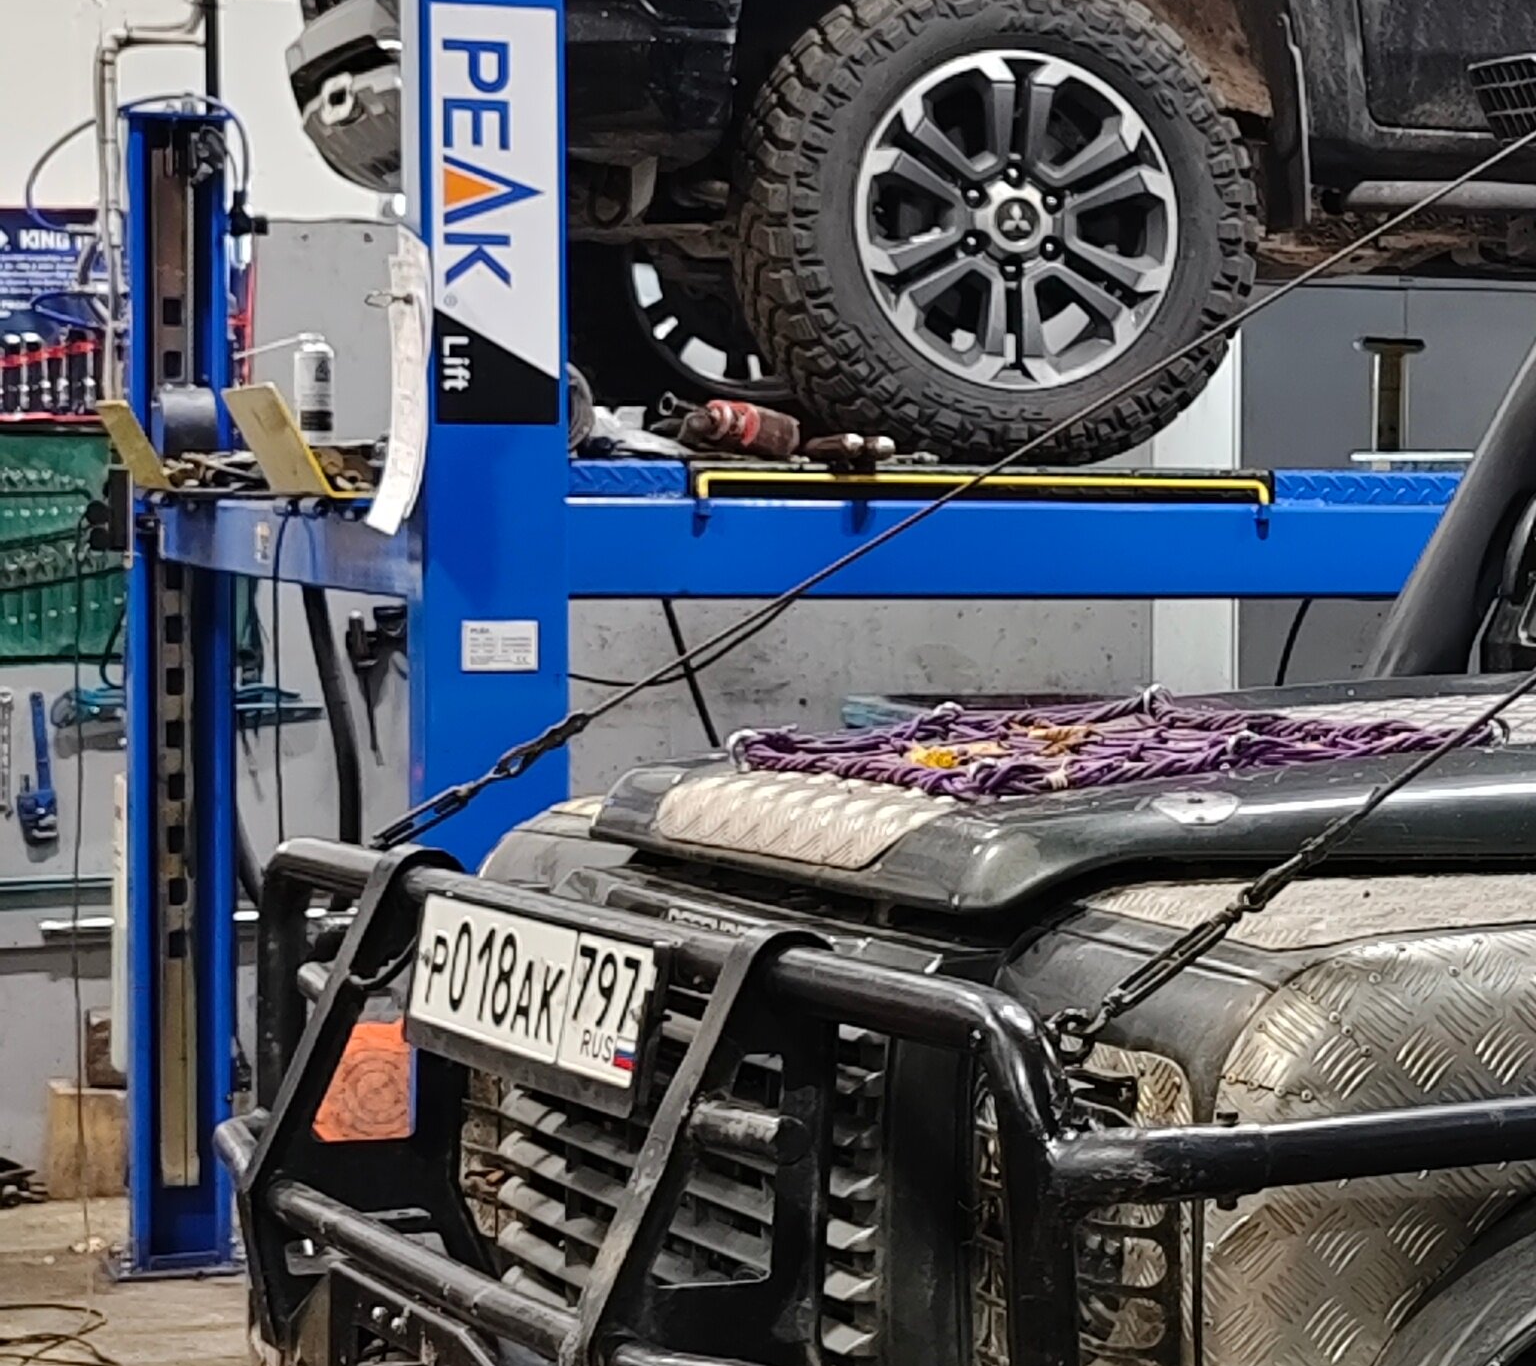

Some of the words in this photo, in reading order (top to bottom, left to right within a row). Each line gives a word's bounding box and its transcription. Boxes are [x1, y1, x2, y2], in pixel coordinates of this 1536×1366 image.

[442, 38, 544, 288] PEAK
[20, 228, 71, 251] KING
[443, 335, 471, 391] Lift
[572, 944, 642, 1034] 797
[579, 1030, 616, 1064] RUS
